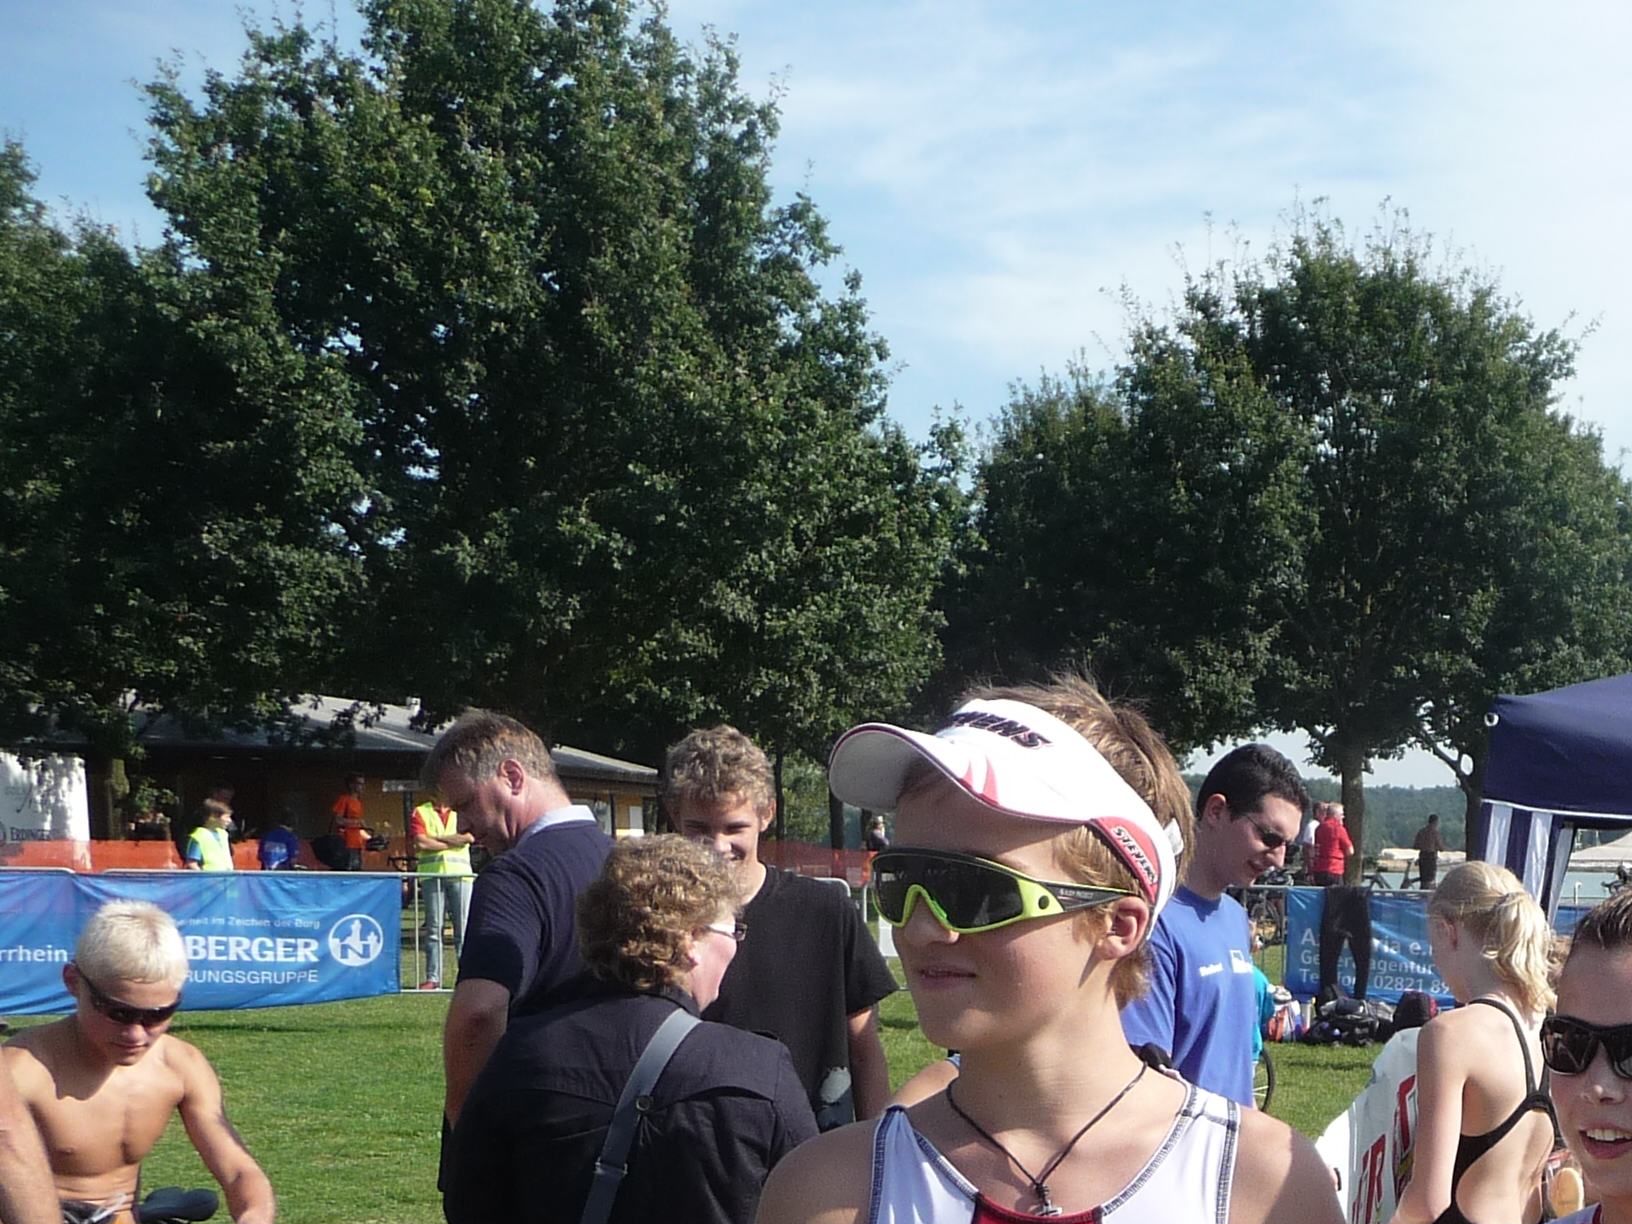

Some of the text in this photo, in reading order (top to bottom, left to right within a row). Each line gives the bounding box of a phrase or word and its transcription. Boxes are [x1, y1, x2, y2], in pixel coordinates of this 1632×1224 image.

[184, 935, 320, 963] BERGER
[184, 969, 320, 984] RUNGSGRUPPE
[1374, 974, 1424, 991] 02821
